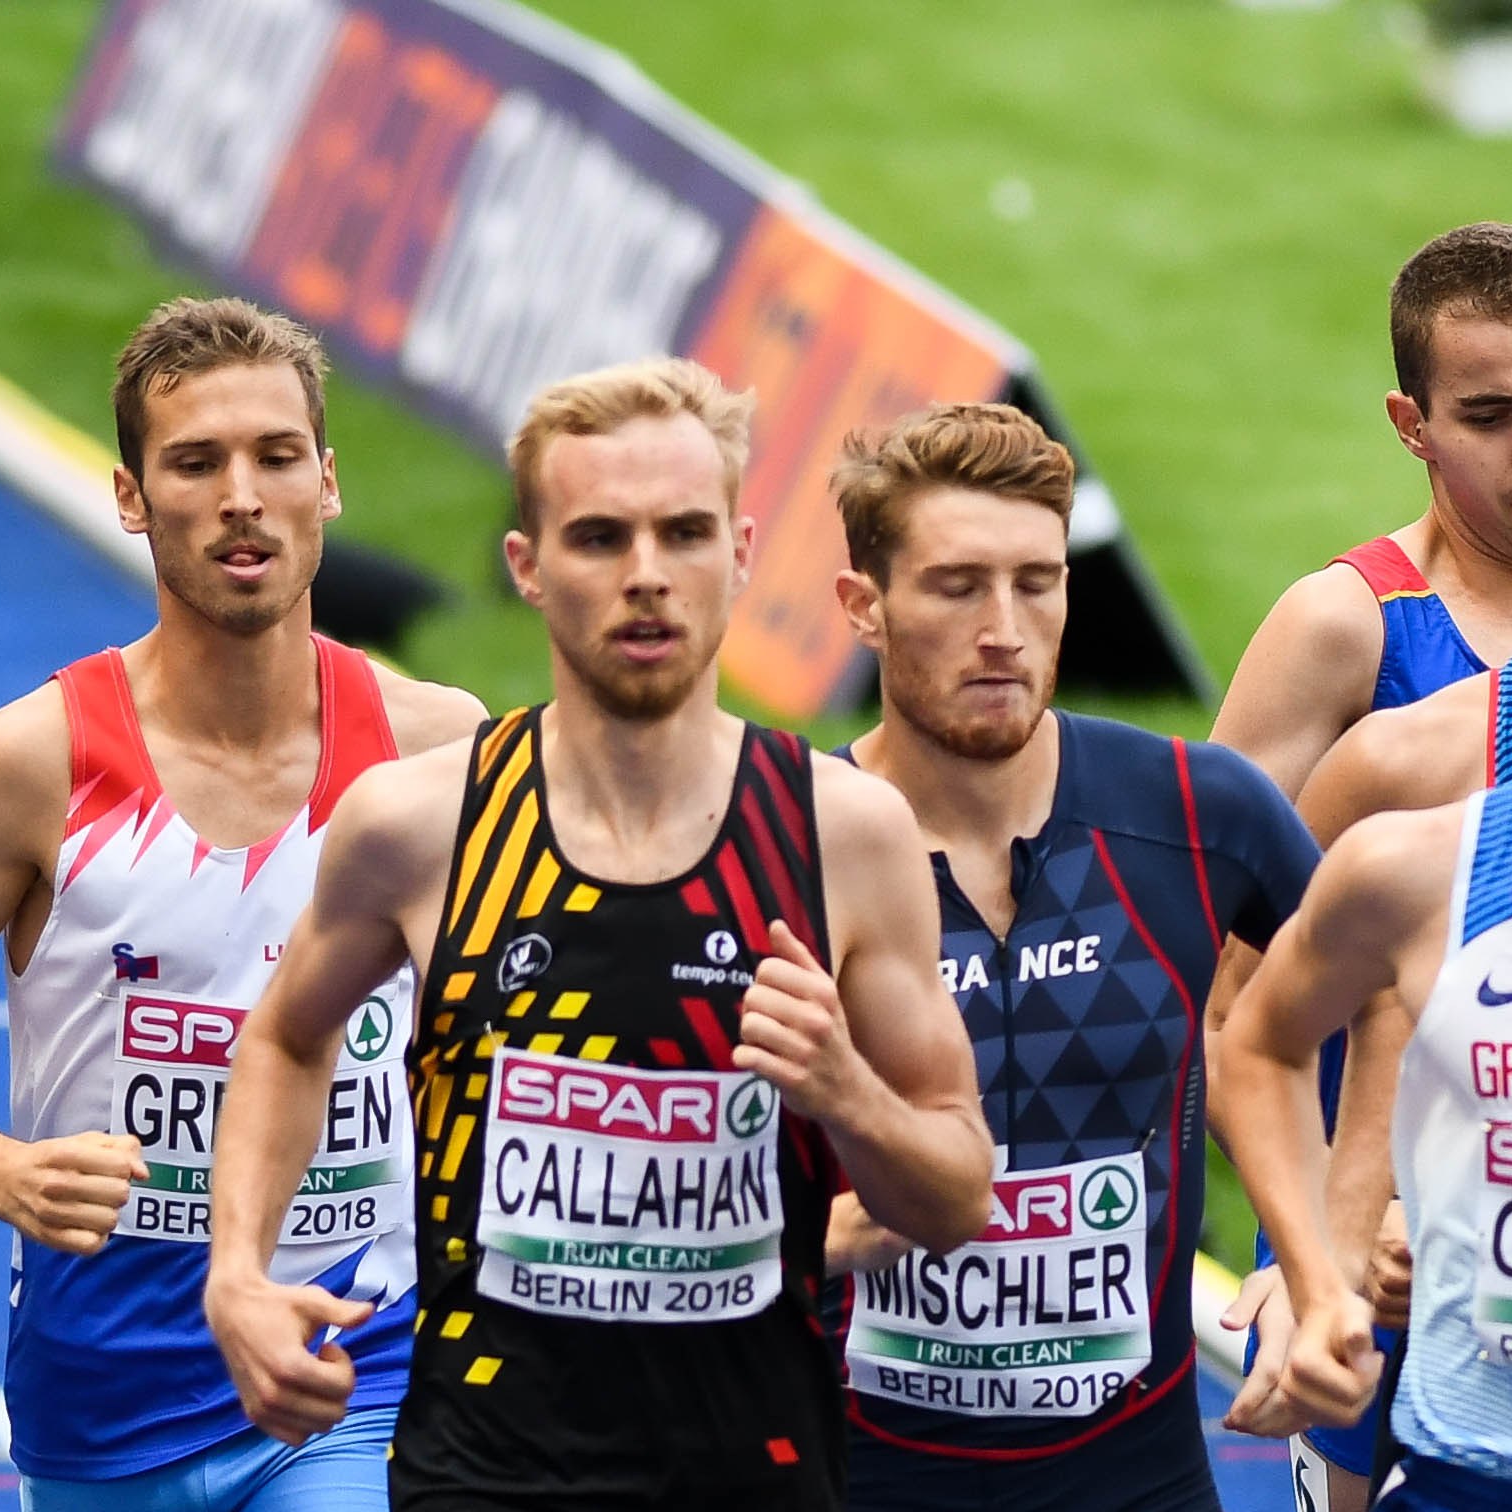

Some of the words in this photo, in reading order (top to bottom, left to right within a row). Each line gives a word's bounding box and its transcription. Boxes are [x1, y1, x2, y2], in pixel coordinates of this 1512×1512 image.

[672, 963, 754, 986] tempo-te
[937, 935, 1101, 993] RANCE
[130, 1005, 240, 1060] SP
[125, 1071, 392, 1154] GREN
[503, 1065, 714, 1134] SPAR
[496, 1136, 769, 1232] CALLAHAN
[136, 1196, 212, 1235] BER
[291, 1197, 376, 1237] 2018
[563, 1241, 619, 1267] RUN
[511, 1264, 652, 1313] BERLIN
[664, 1273, 755, 1312] 2018
[865, 1243, 1136, 1330] MISCHLER
[917, 1340, 924, 1360] I
[930, 1341, 983, 1366] RUN
[877, 1365, 1017, 1409] BERLIN
[1032, 1371, 1125, 1409] 2018
